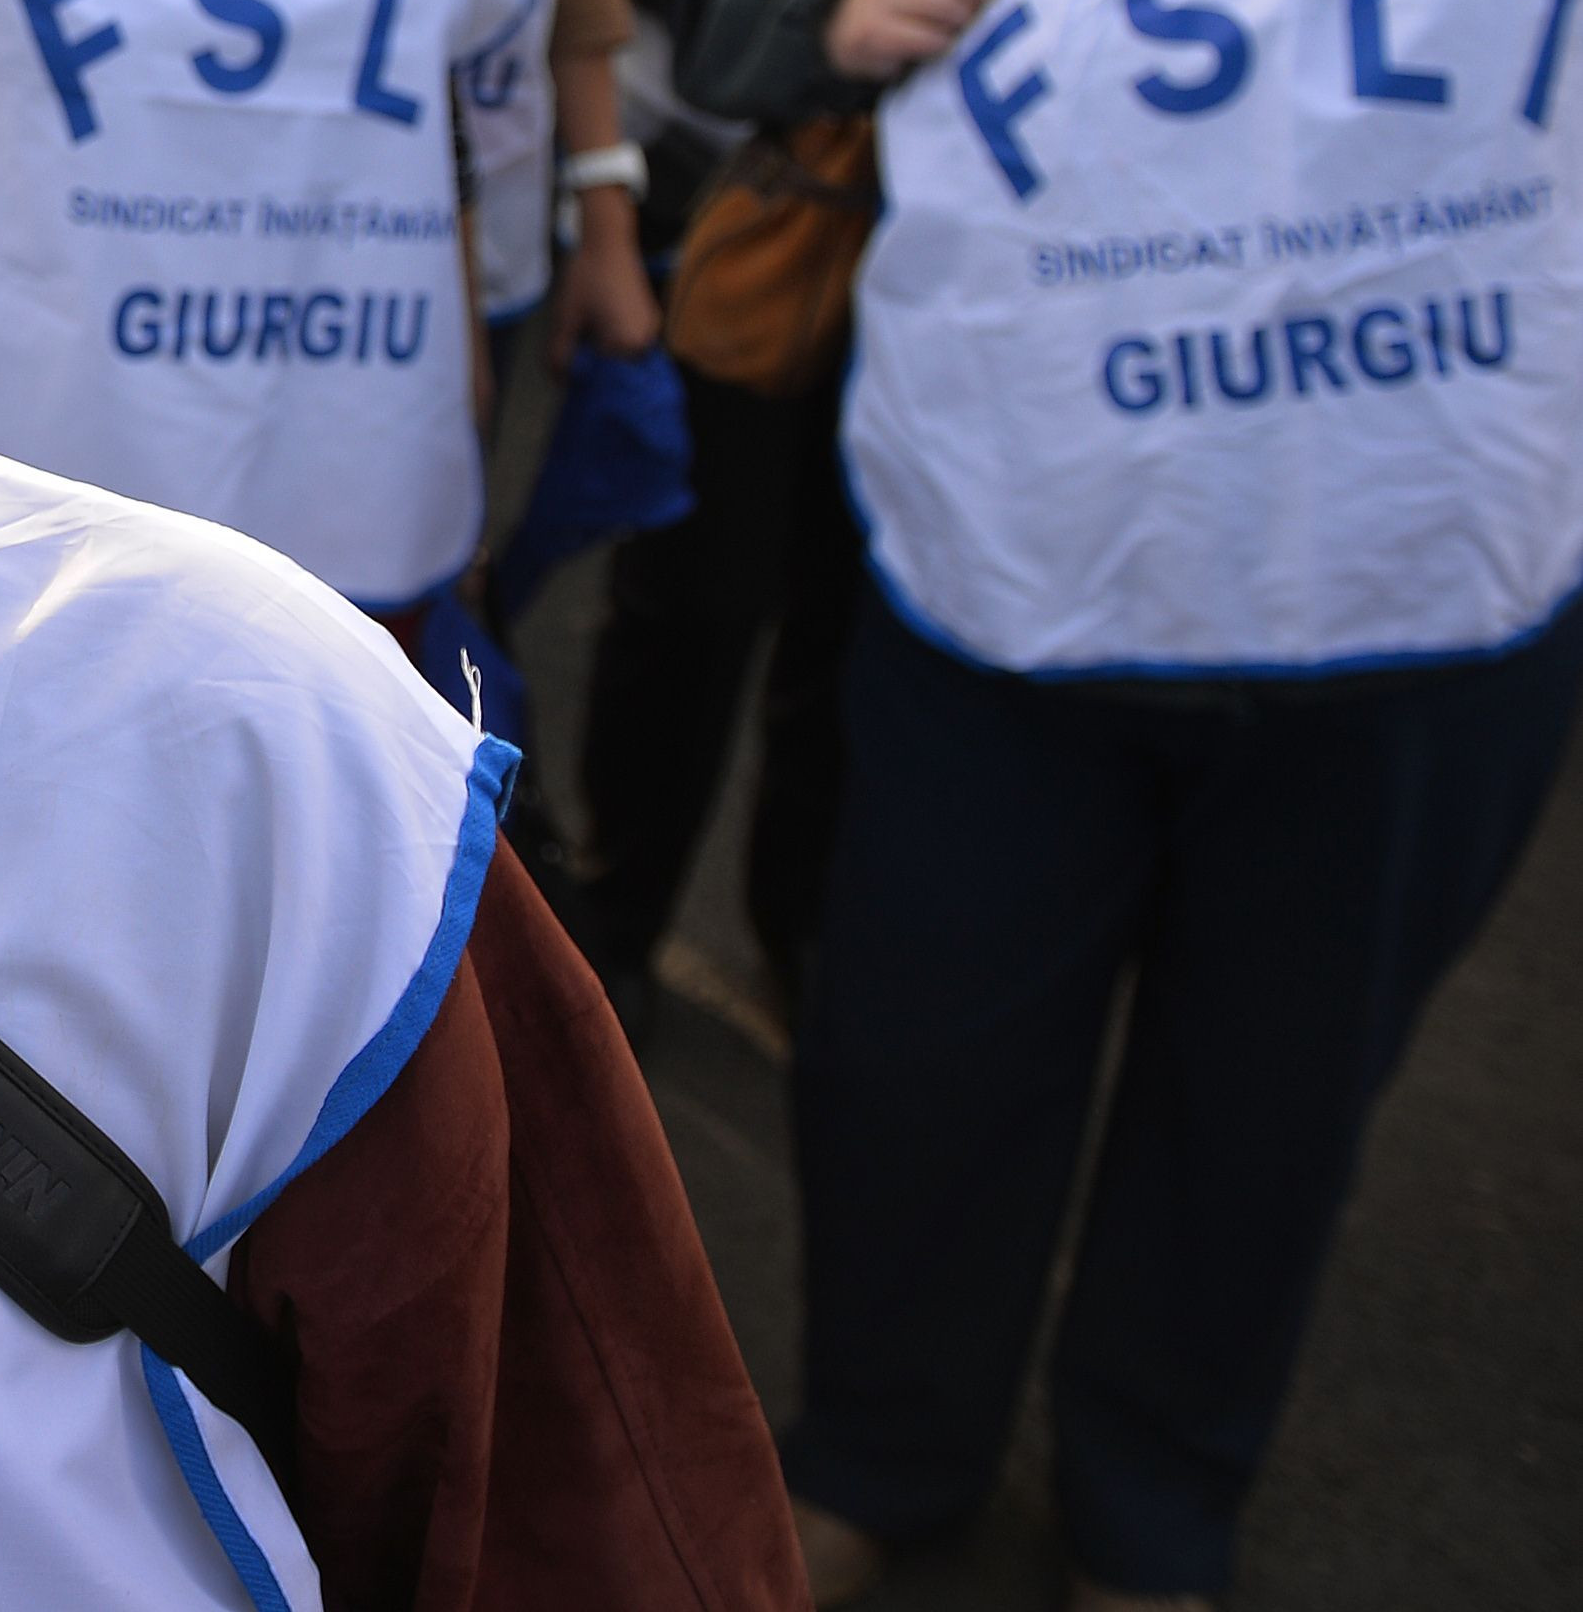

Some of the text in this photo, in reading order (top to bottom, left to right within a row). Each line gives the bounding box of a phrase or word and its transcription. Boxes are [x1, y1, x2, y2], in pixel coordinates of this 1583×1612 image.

[69, 192, 247, 235] SINDICAT
[1034, 226, 1246, 284] SINDICAT
[113, 288, 430, 364] GIURGIU
[1103, 290, 1515, 416] GIURGIU
